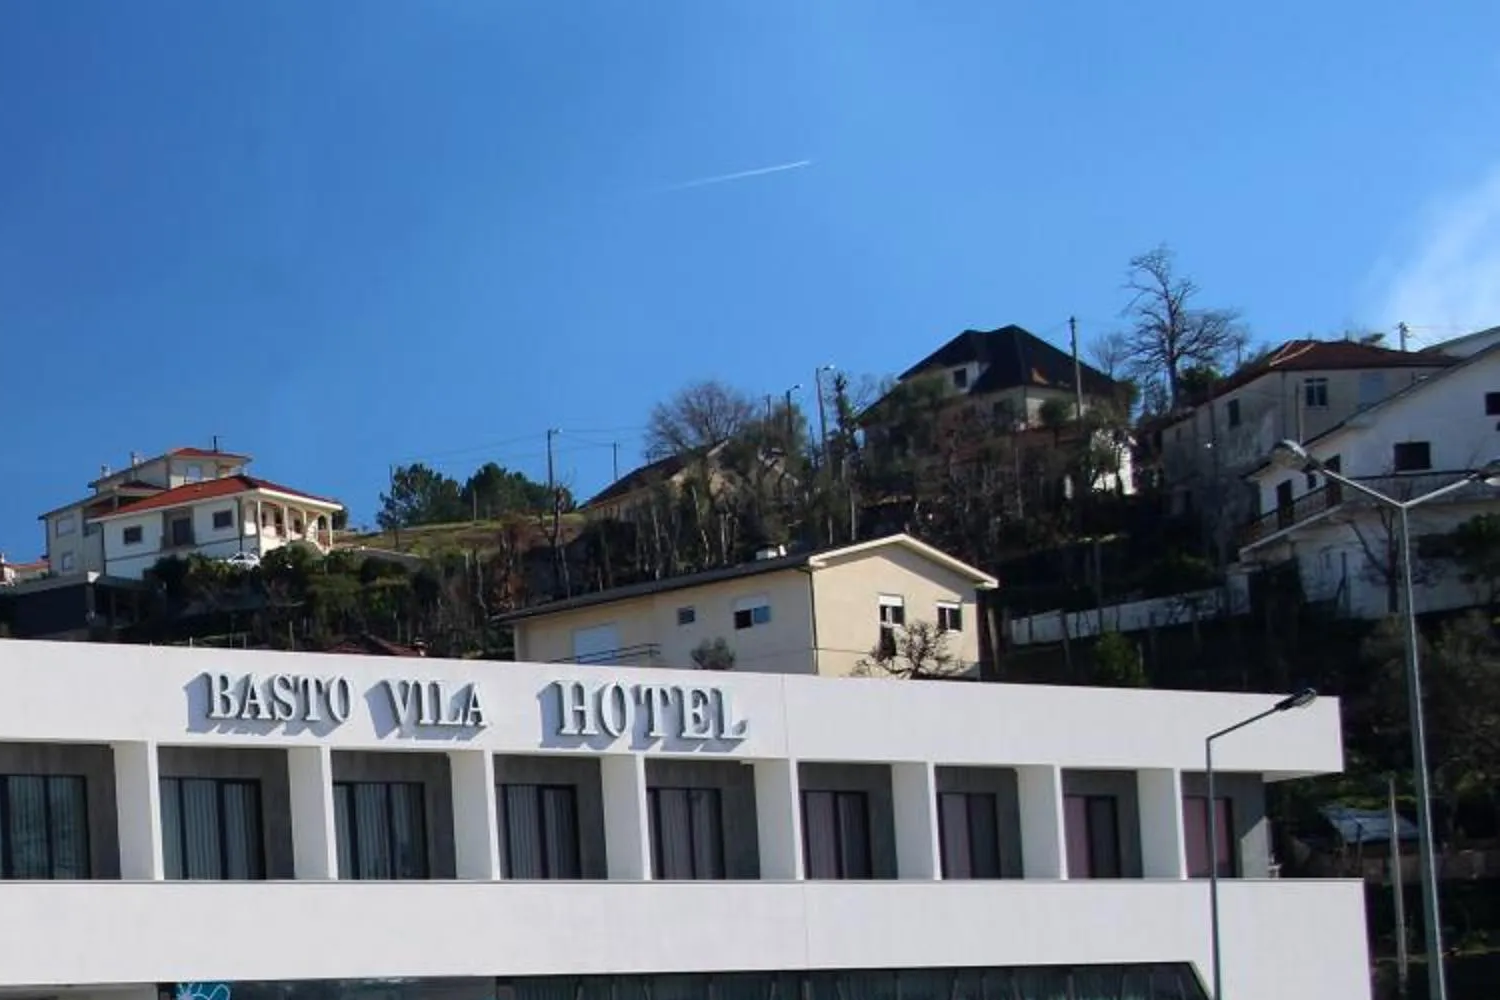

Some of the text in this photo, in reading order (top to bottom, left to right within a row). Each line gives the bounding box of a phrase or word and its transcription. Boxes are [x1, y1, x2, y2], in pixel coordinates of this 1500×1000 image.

[201, 672, 749, 739] BASTO VILA HOTEL
